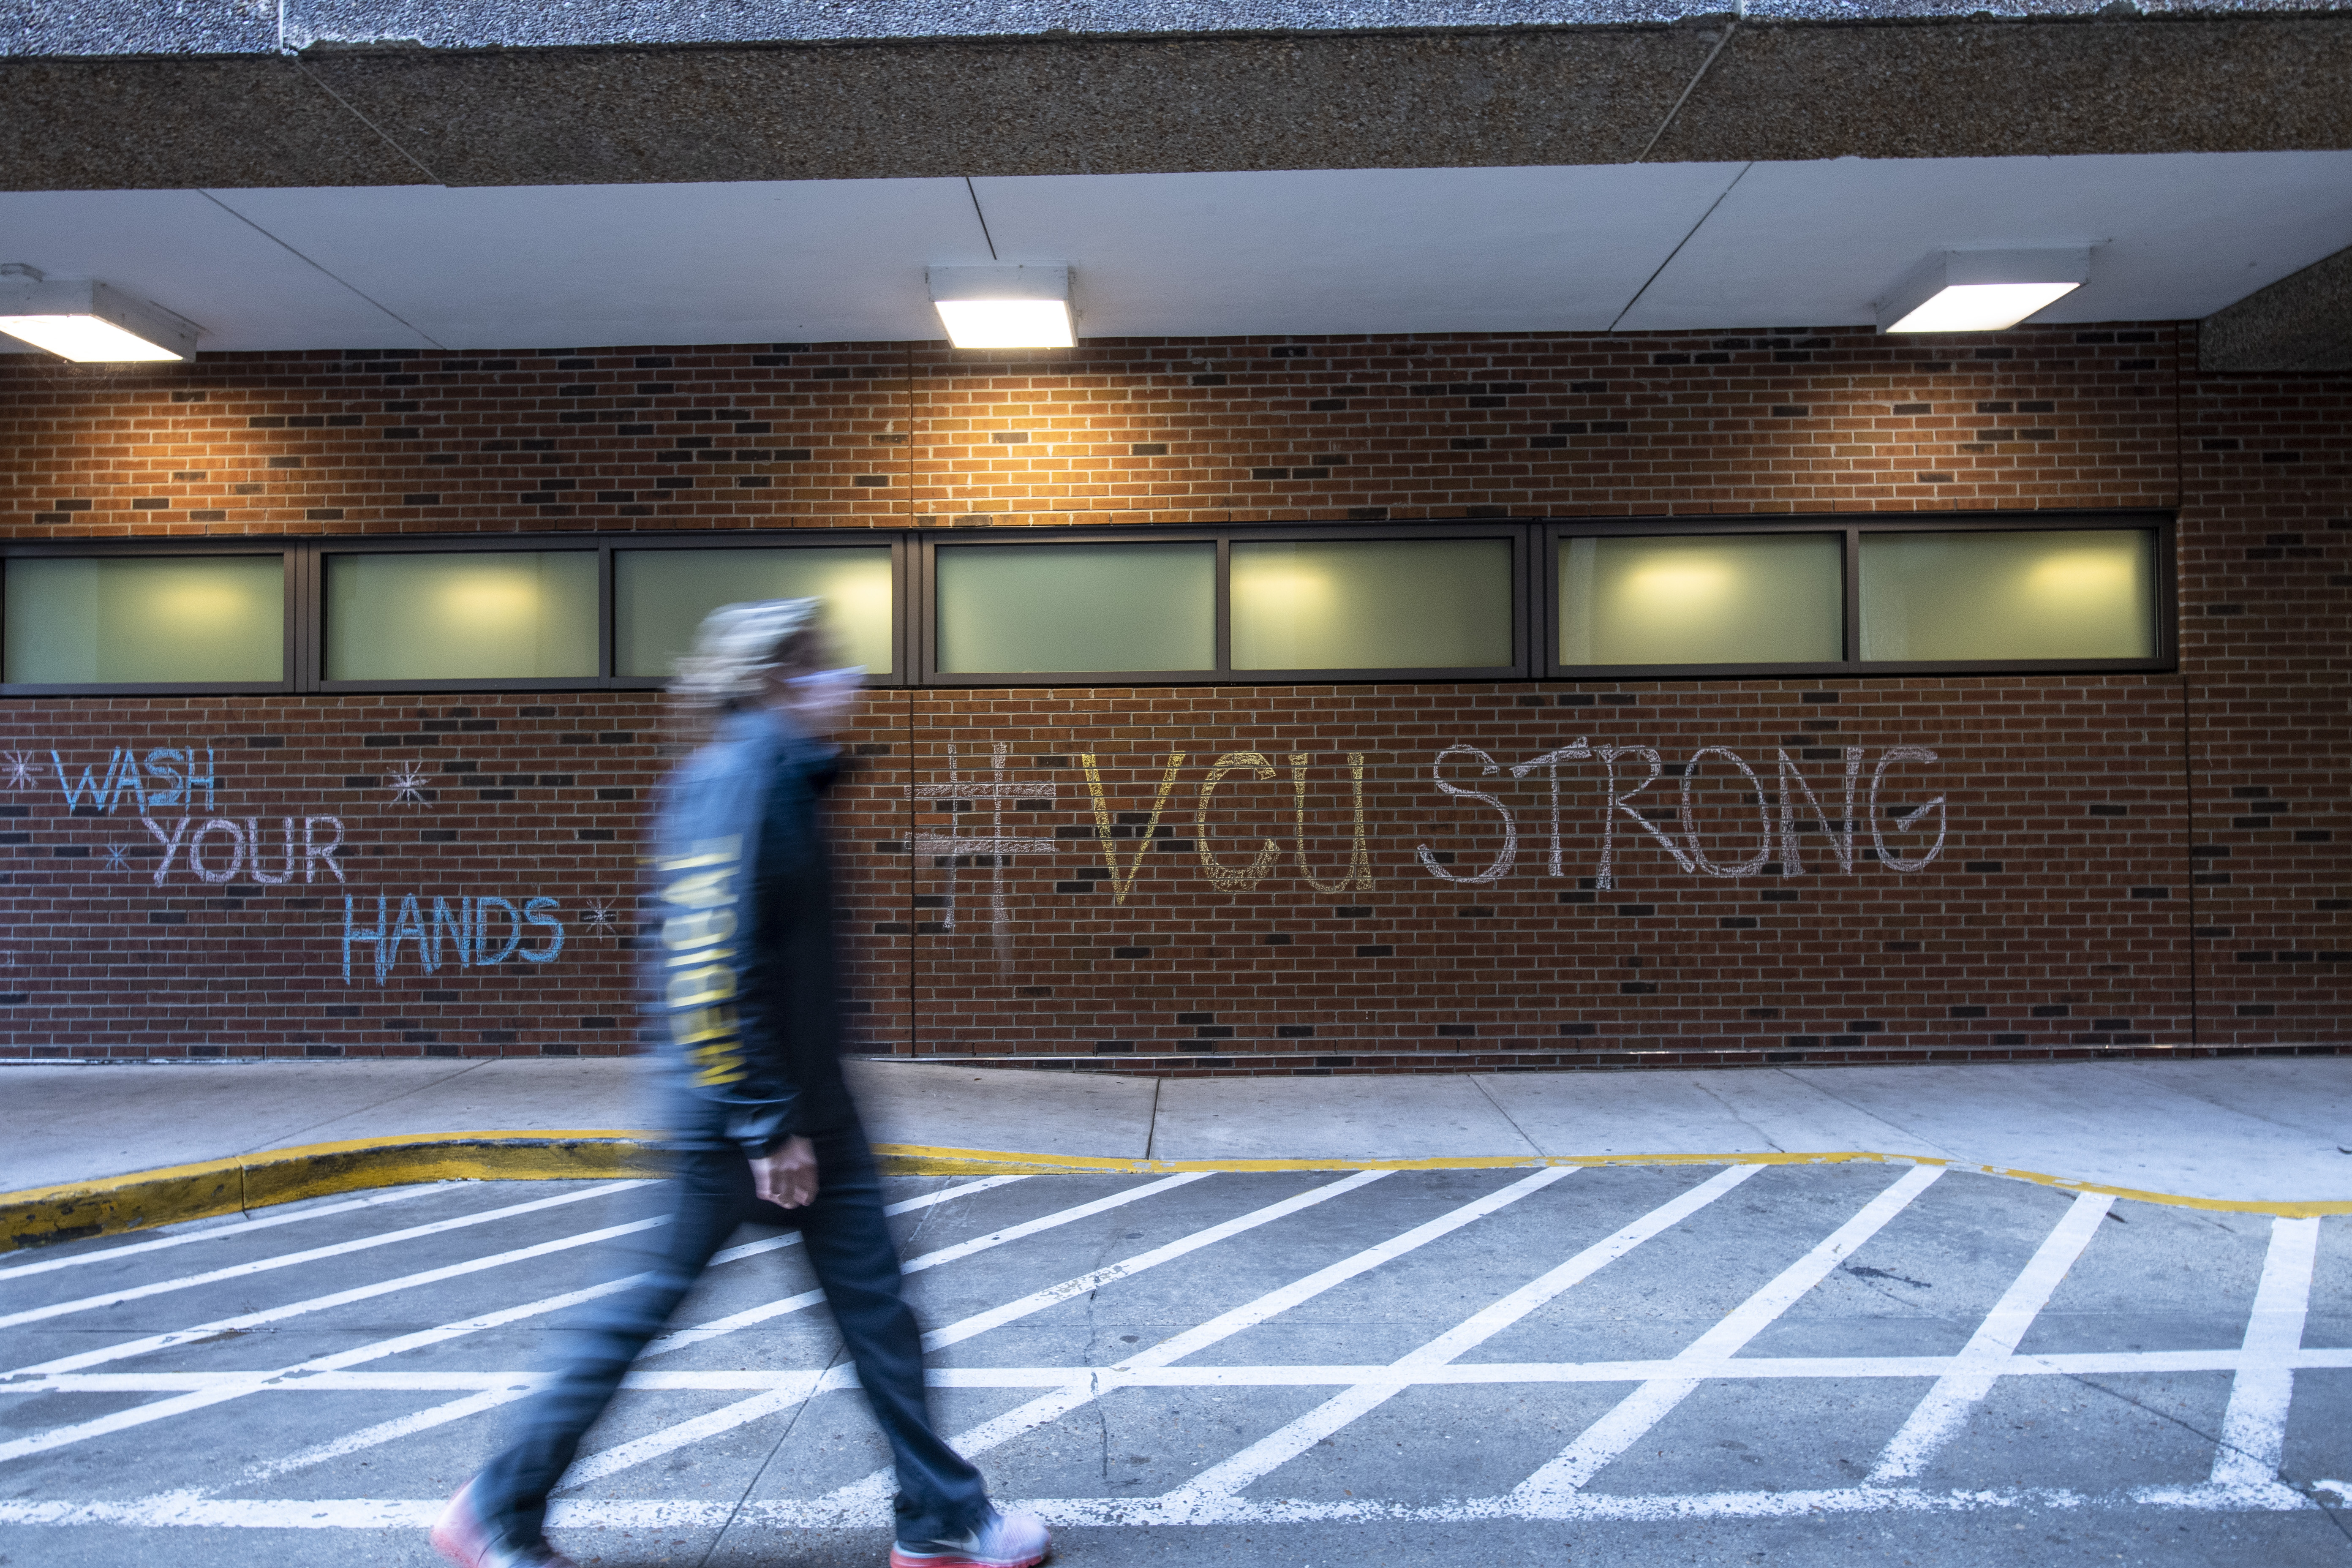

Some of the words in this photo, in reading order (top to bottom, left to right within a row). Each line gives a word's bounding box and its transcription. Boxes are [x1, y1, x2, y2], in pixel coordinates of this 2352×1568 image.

[52, 746, 214, 814] WASH
[1417, 737, 1944, 890] STRONG
[142, 813, 346, 888] YOUR
[343, 893, 565, 987] HANDS
